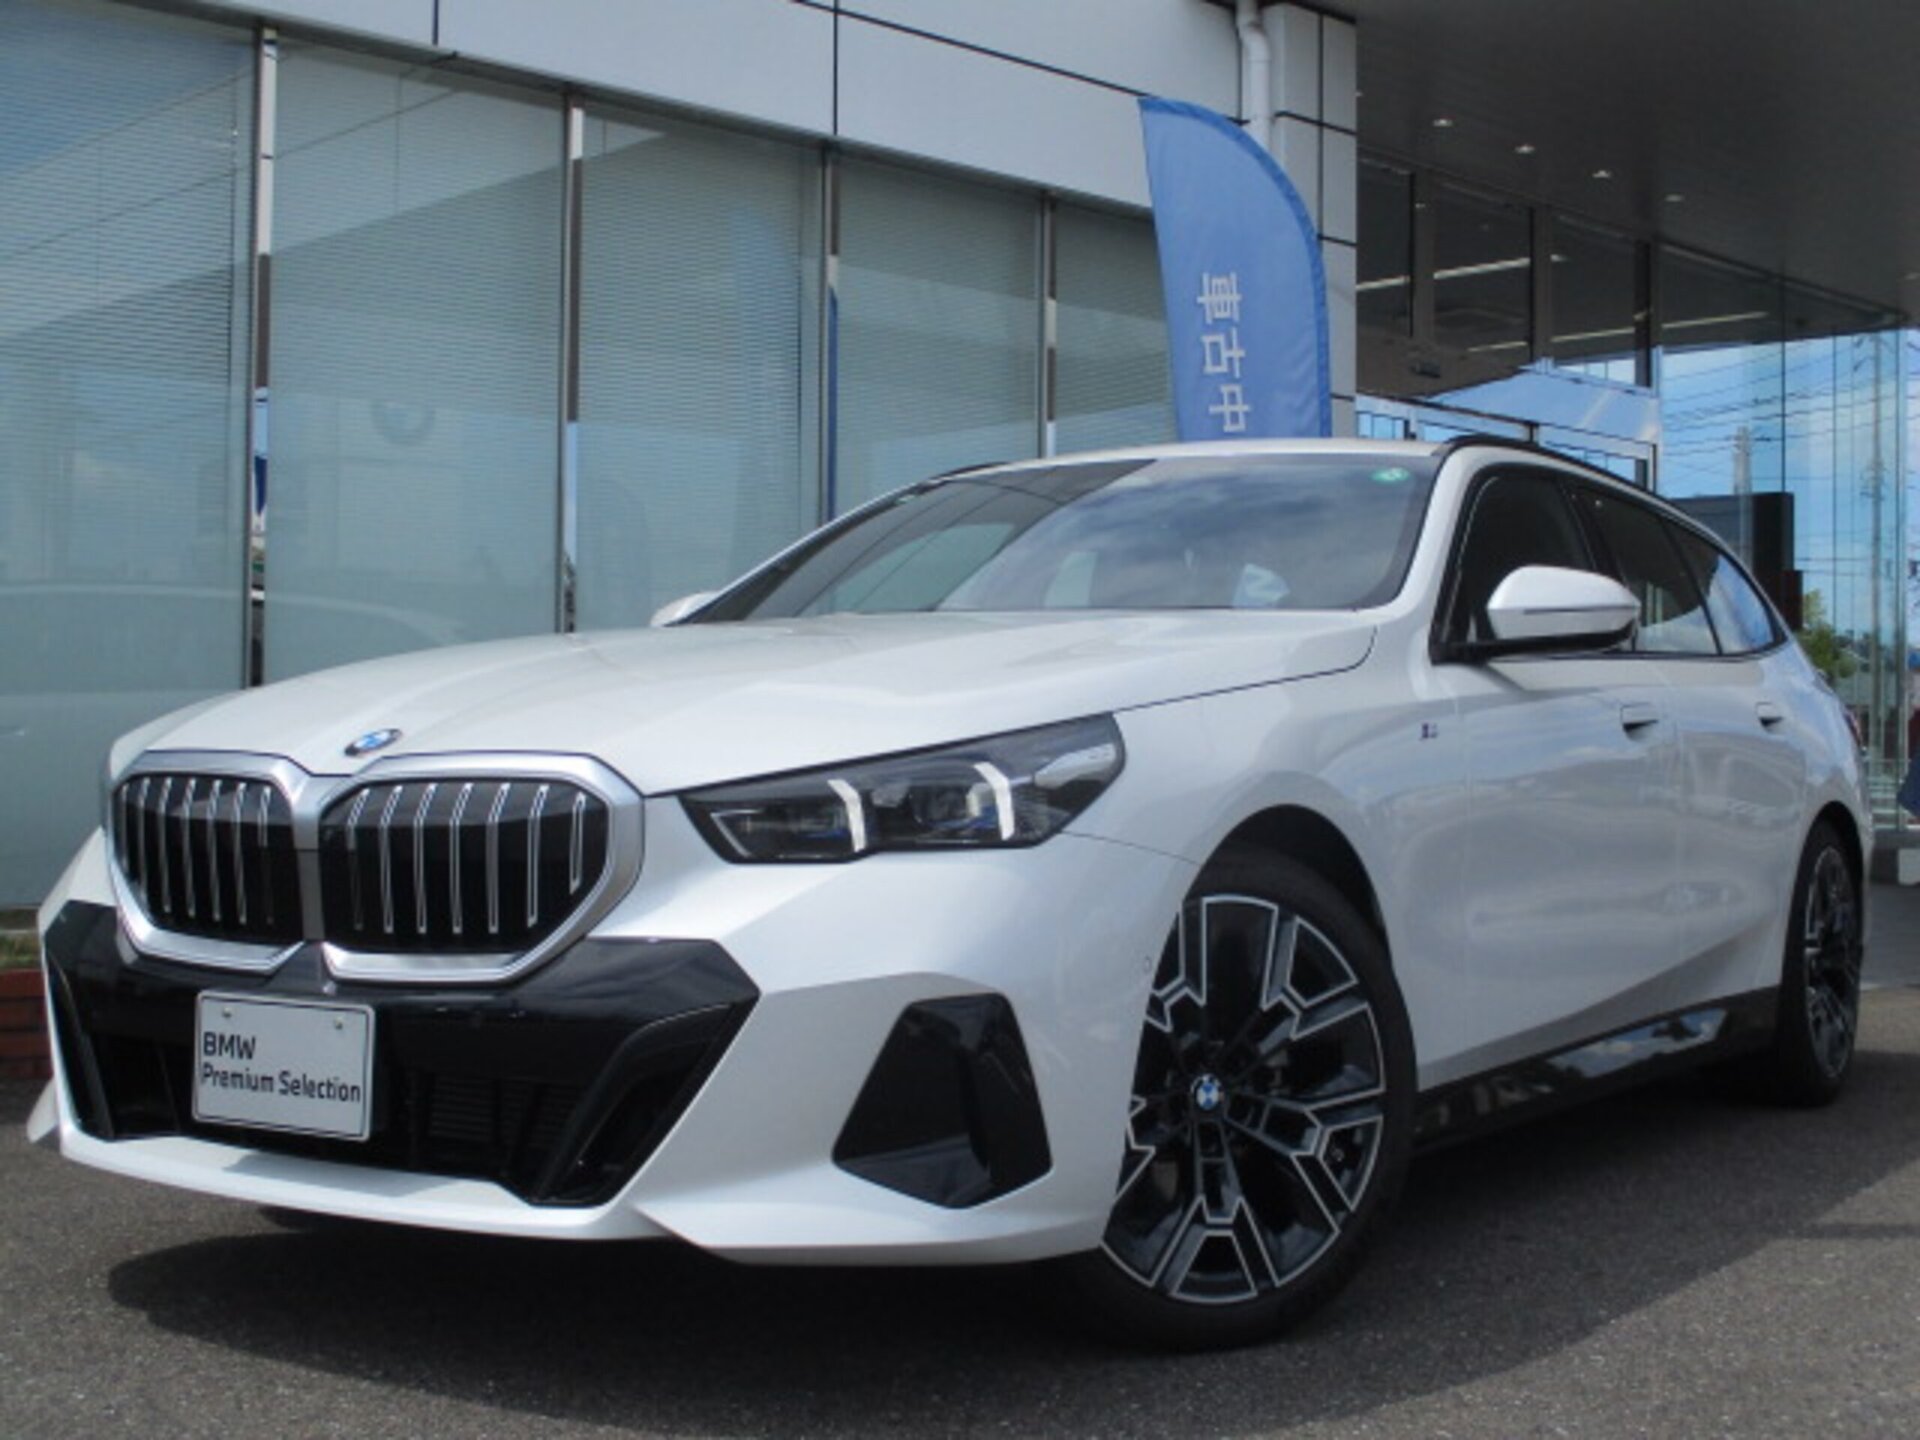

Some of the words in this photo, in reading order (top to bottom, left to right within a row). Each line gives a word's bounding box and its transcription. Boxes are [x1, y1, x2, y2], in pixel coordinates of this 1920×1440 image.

[203, 1031, 256, 1060] BMW
[202, 1061, 275, 1093] Premium
[278, 1070, 361, 1103] Selection
